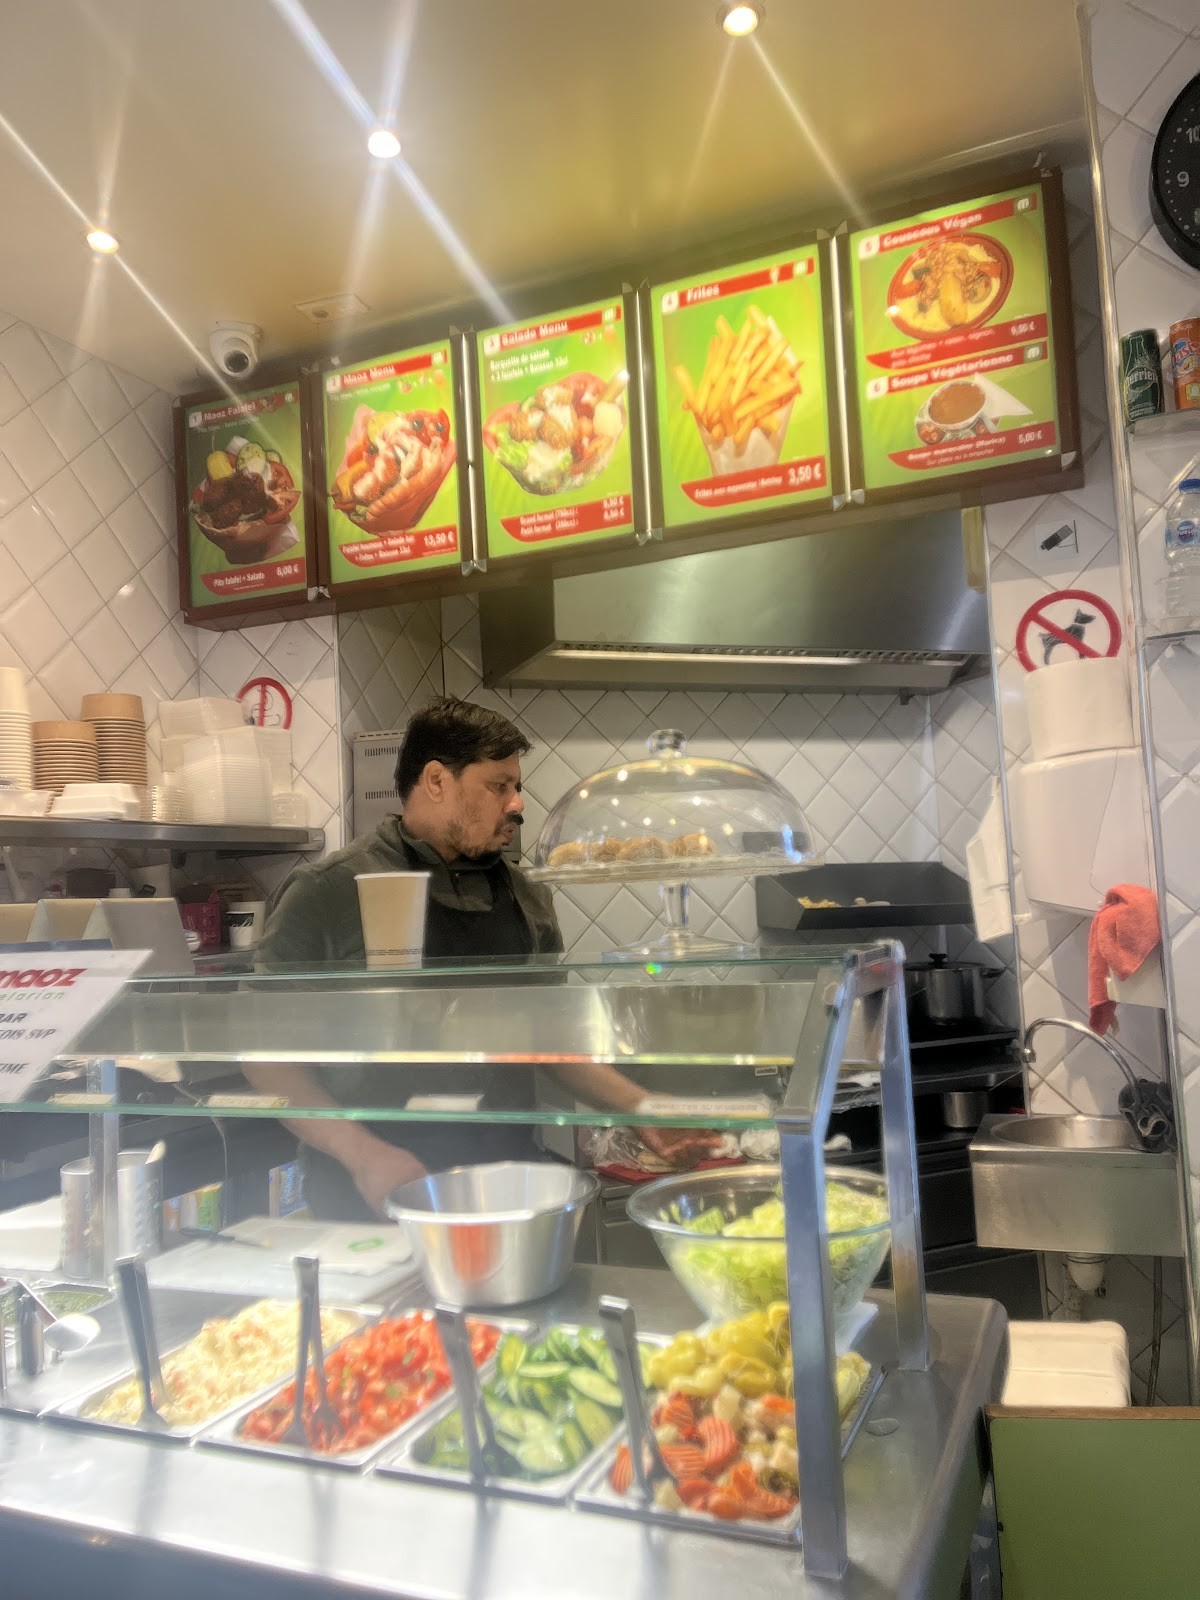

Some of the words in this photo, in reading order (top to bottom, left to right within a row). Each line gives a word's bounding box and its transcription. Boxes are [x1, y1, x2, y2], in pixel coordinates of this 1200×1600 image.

[1176, 170, 1190, 188] 9
[882, 224, 942, 249] Couscous
[942, 213, 983, 232] Végan
[686, 284, 721, 304] Frites
[501, 328, 537, 347] Salade
[538, 320, 569, 337] Menu
[529, 347, 550, 362] salade
[369, 364, 397, 379] Menu
[890, 372, 930, 390] Soupe
[929, 354, 1014, 382] Végétarienne
[203, 410, 227, 422] Maoz
[227, 402, 257, 417] Falafel
[787, 463, 812, 487] 3,50
[813, 461, 822, 481] €
[423, 531, 446, 547] 13,50
[246, 571, 266, 583] Salade
[25, 1028, 57, 1040] SVP
